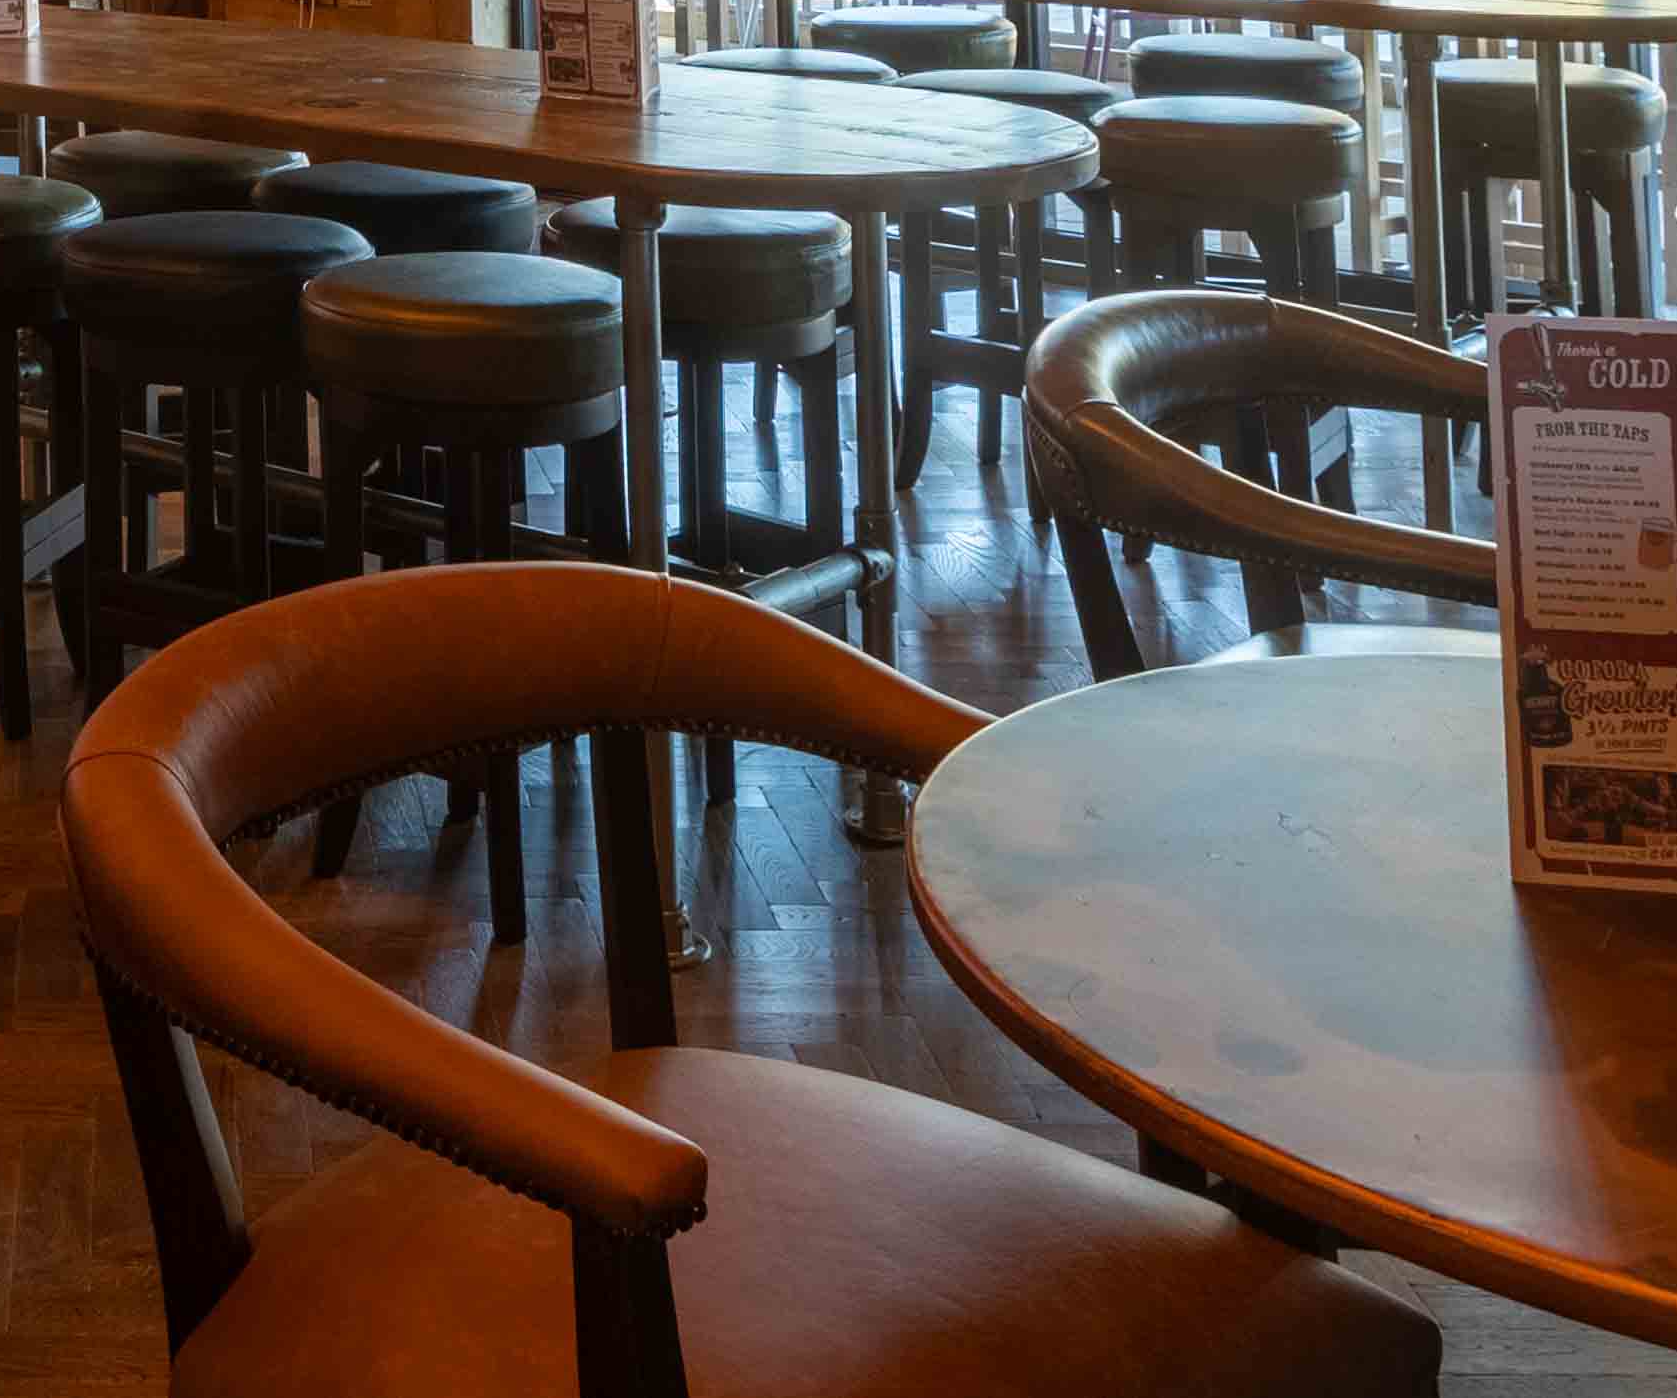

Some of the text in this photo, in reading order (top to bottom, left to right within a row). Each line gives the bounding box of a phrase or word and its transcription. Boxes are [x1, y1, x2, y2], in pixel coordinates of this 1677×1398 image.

[1556, 342, 1601, 357] There's
[1588, 359, 1670, 389] COLD
[1535, 422, 1650, 443] FROM THE TAPS
[1621, 719, 1669, 735] PINTS
